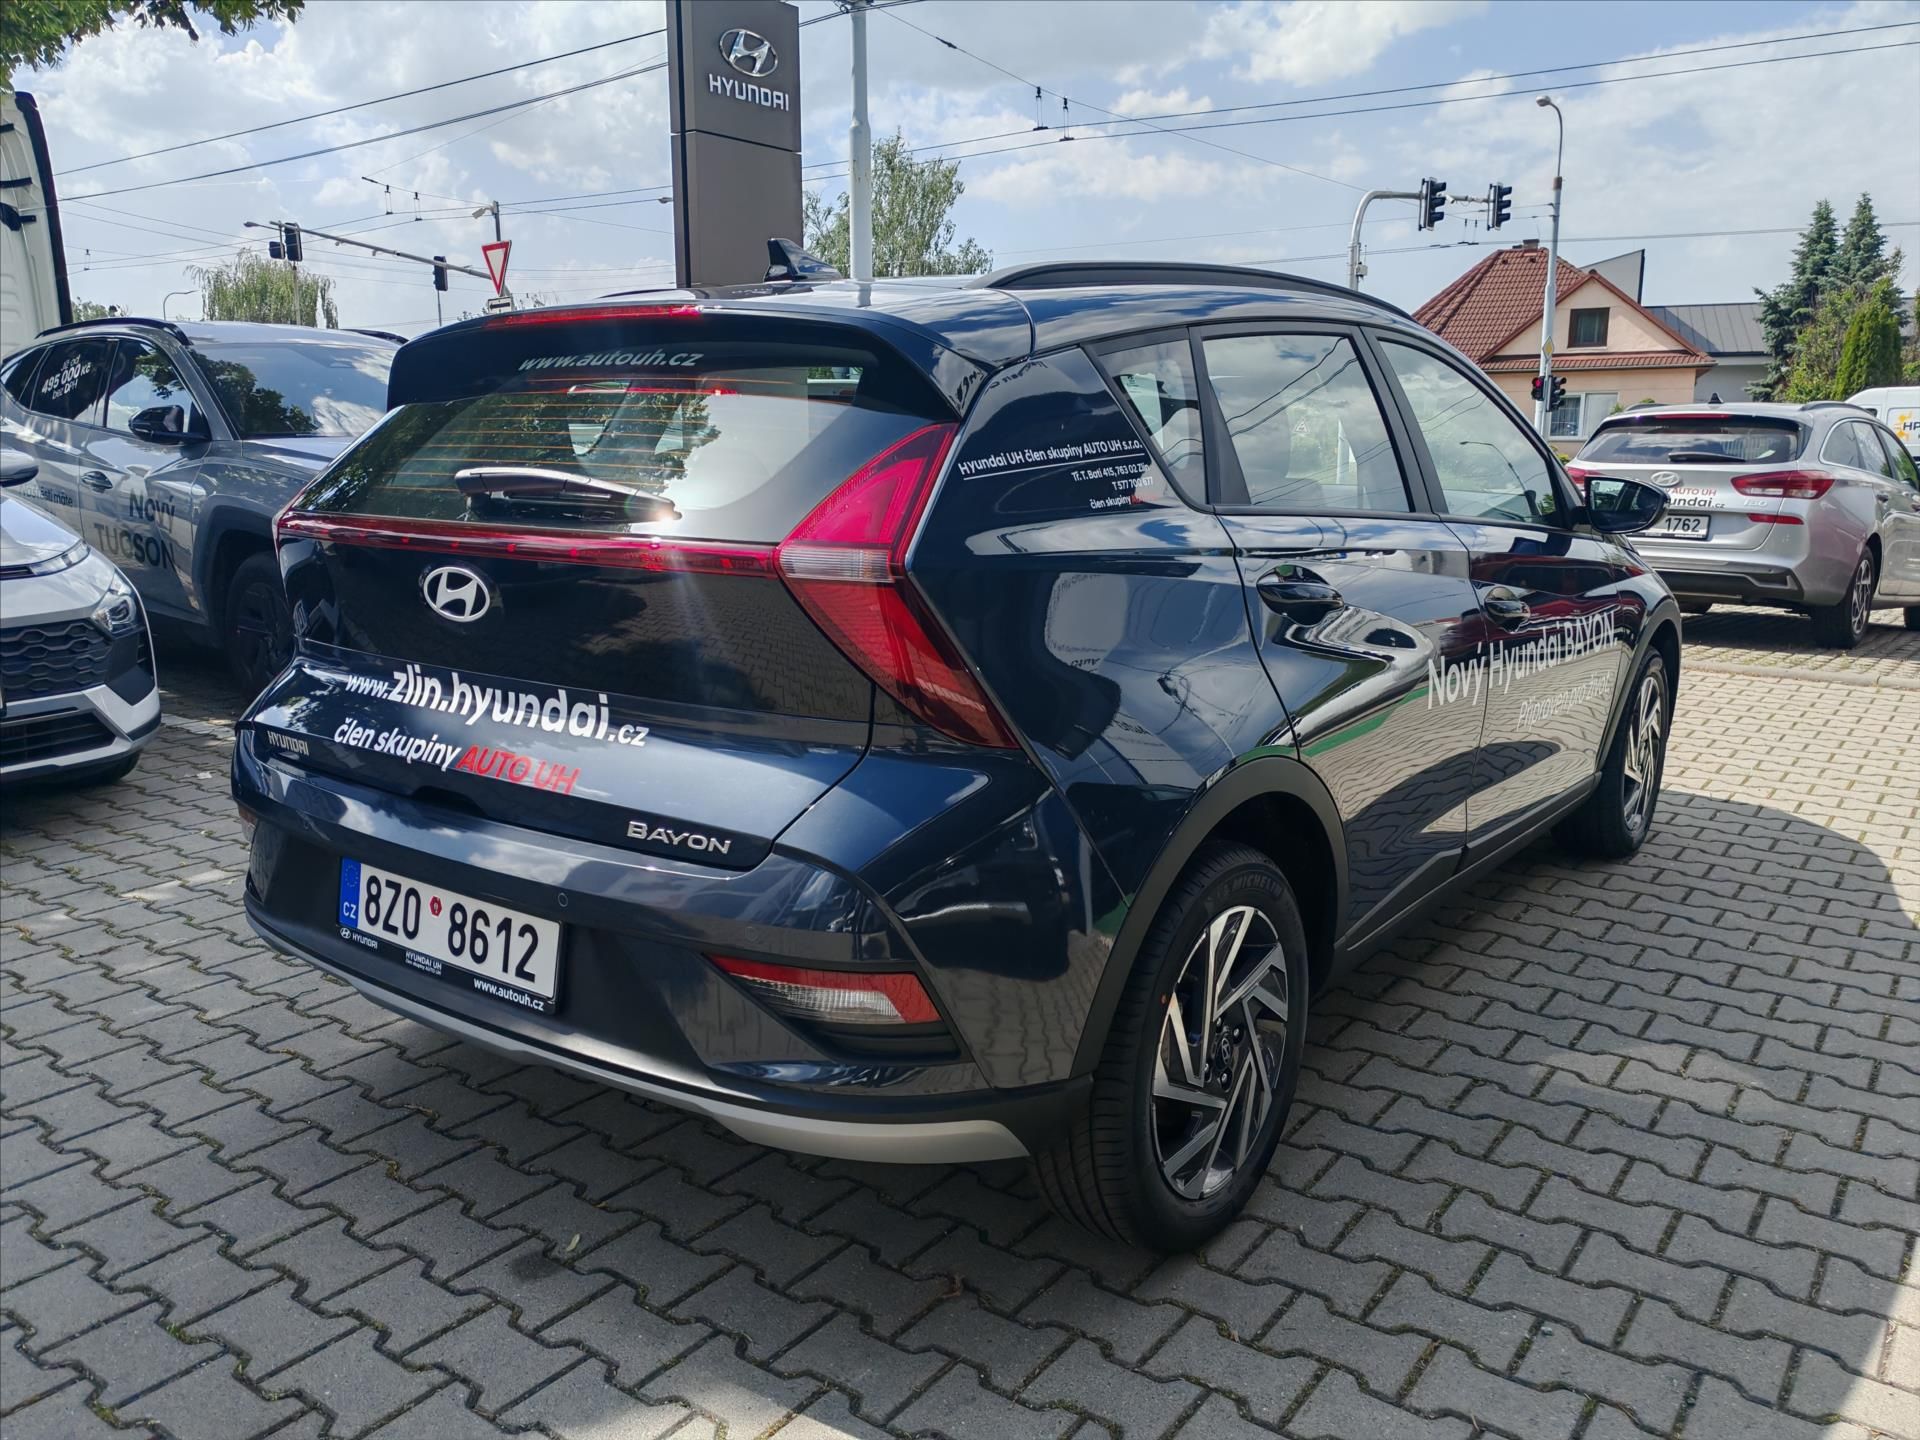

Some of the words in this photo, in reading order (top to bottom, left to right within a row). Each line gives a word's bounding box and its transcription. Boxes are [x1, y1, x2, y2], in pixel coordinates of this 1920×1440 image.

[708, 73, 789, 112] HYUNDAI
[518, 349, 704, 371] www.autouh.cz
[41, 373, 61, 394] 495
[61, 363, 81, 385] 000
[957, 454, 1007, 475] Hyundai
[1007, 451, 1025, 464] UH
[1025, 449, 1048, 463] člen
[1047, 443, 1083, 464] skupiny
[1083, 442, 1108, 455] AUTO
[1108, 440, 1122, 452] UH
[1122, 440, 1143, 450] s.r.o.
[1105, 494, 1131, 508] skupiny
[1671, 487, 1699, 495] AUTO
[1701, 487, 1717, 496] UH
[129, 488, 176, 534] Nový
[1665, 516, 1701, 532] 1762
[93, 522, 176, 571] TUCSON
[1427, 641, 1485, 710] Nový
[1488, 622, 1561, 694] Hyundai
[345, 664, 650, 747] www.zlin.hyundai.cz
[267, 730, 311, 756] HYUNDAI
[333, 717, 376, 749] člen
[374, 728, 461, 772] skupiny
[456, 744, 534, 784] AUTO
[534, 759, 582, 795] UH
[626, 820, 731, 855] BAYON
[342, 901, 356, 920] CZ
[352, 932, 378, 950] HYUNDAI
[365, 875, 422, 940] 8Z0
[448, 902, 539, 984] 8612
[405, 950, 432, 966] HYUNDAI
[432, 960, 442, 971] UH
[473, 978, 544, 1012] www.autouh.cz
